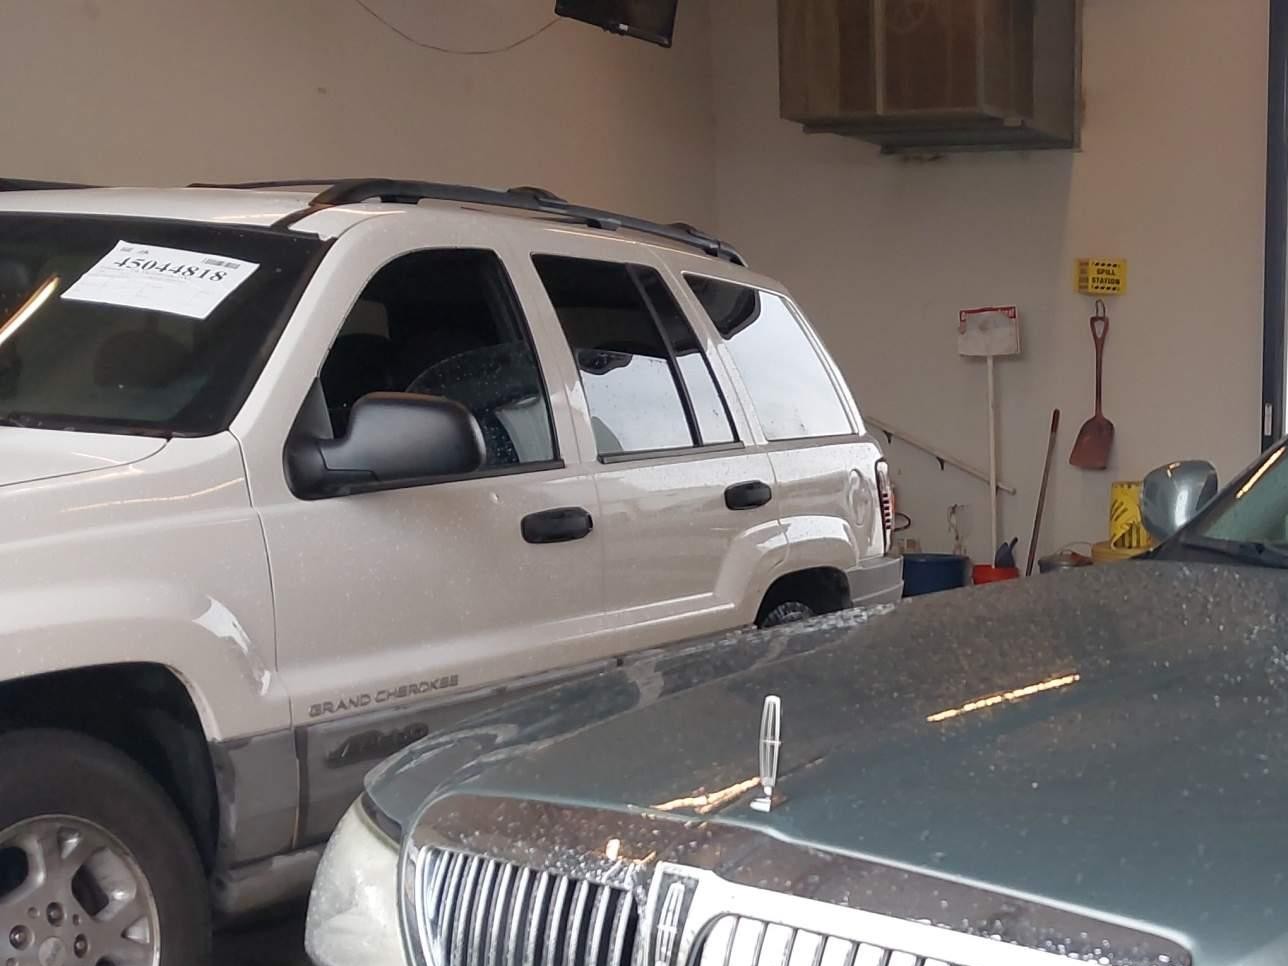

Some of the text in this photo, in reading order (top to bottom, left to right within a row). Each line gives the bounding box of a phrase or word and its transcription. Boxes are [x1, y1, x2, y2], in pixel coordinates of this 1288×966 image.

[113, 256, 228, 283] 45044818
[1096, 268, 1116, 276] SPILL
[1091, 276, 1121, 285] STATION
[308, 674, 460, 718] GRAND CHEROKEE
